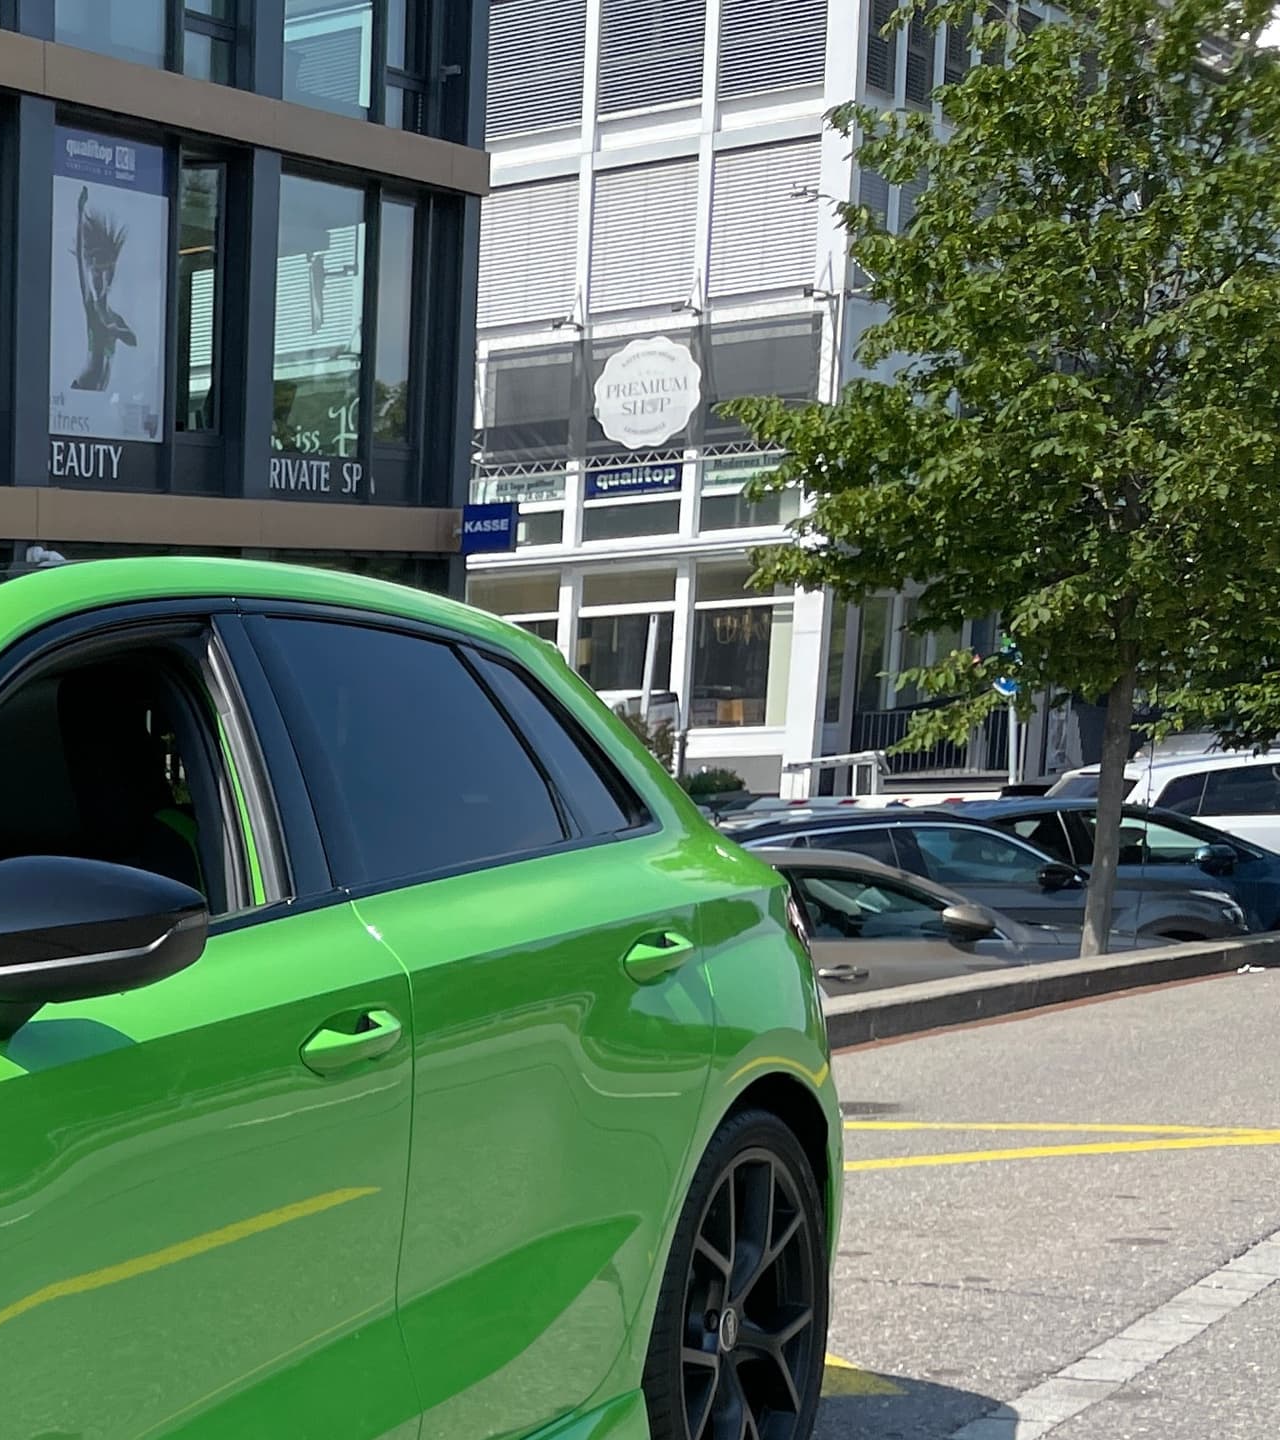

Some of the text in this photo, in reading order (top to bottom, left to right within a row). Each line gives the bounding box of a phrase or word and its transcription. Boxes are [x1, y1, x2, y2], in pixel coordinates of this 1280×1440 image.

[606, 376, 689, 399] PREMIUM
[621, 397, 672, 416] SHOP
[48, 441, 123, 479] EAUTY
[341, 462, 375, 495] SP
[596, 467, 676, 490] qualitop
[464, 518, 509, 534] KASSE
